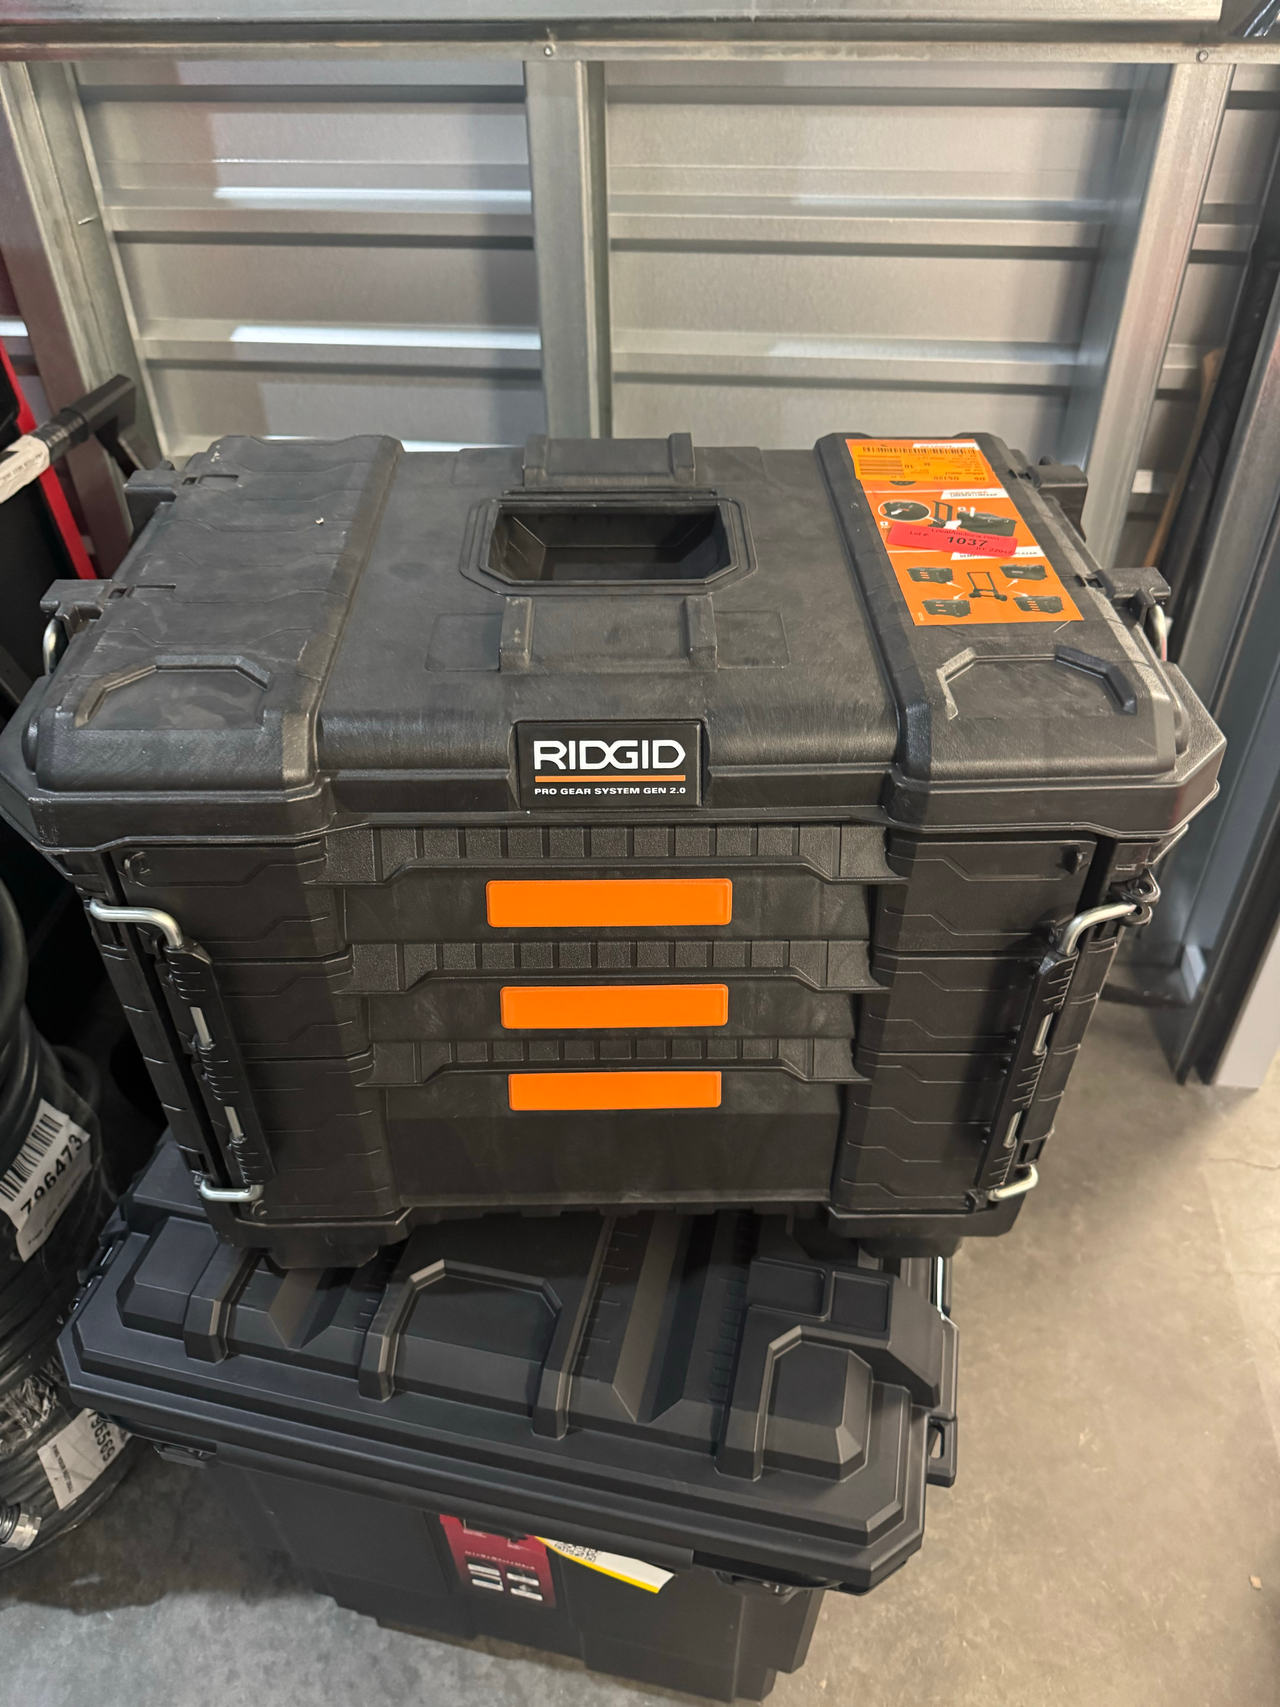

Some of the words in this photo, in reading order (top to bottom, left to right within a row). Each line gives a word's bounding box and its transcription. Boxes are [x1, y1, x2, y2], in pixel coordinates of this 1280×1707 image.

[947, 536, 988, 547] 1037
[533, 739, 686, 770] RIDGID
[594, 787, 640, 795] SYSTEM
